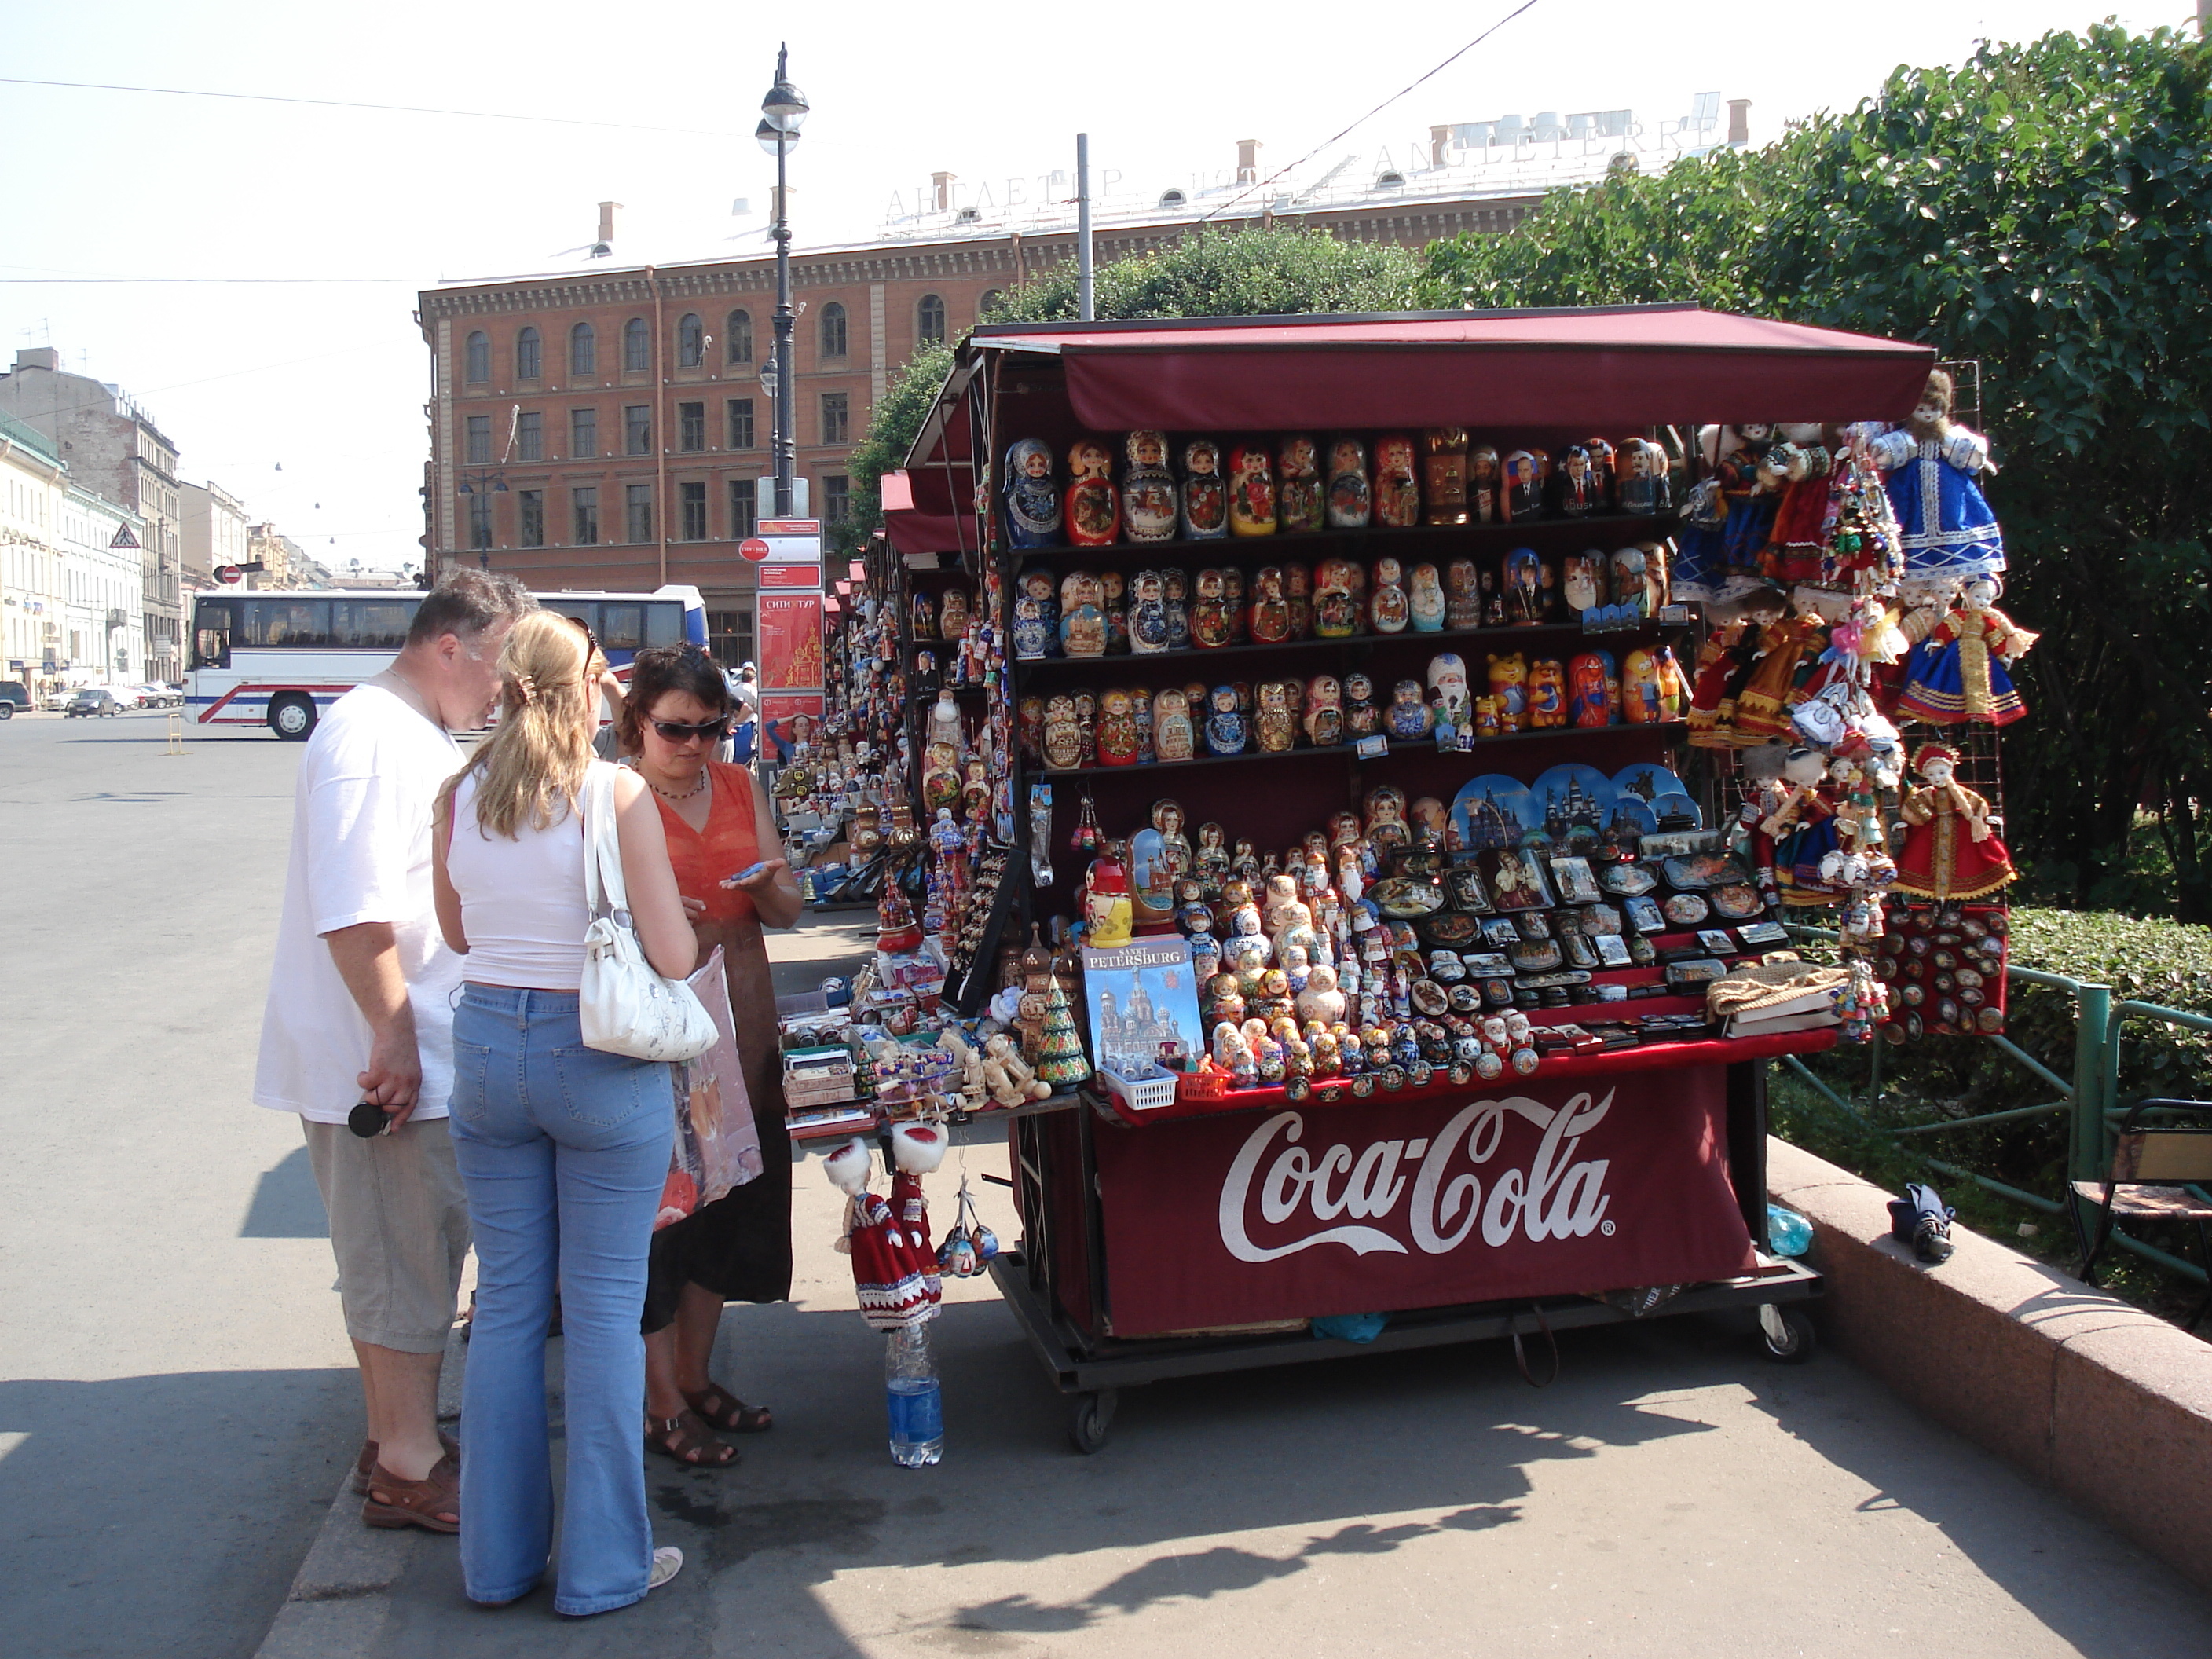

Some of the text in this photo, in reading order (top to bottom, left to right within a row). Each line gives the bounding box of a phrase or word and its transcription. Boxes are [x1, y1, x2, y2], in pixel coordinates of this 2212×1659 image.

[1373, 115, 1722, 174] ANGLETERRE
[765, 599, 815, 610] СИТИ ТУР
[1119, 947, 1148, 956] SANKT
[1089, 951, 1181, 969] PETERSBURG
